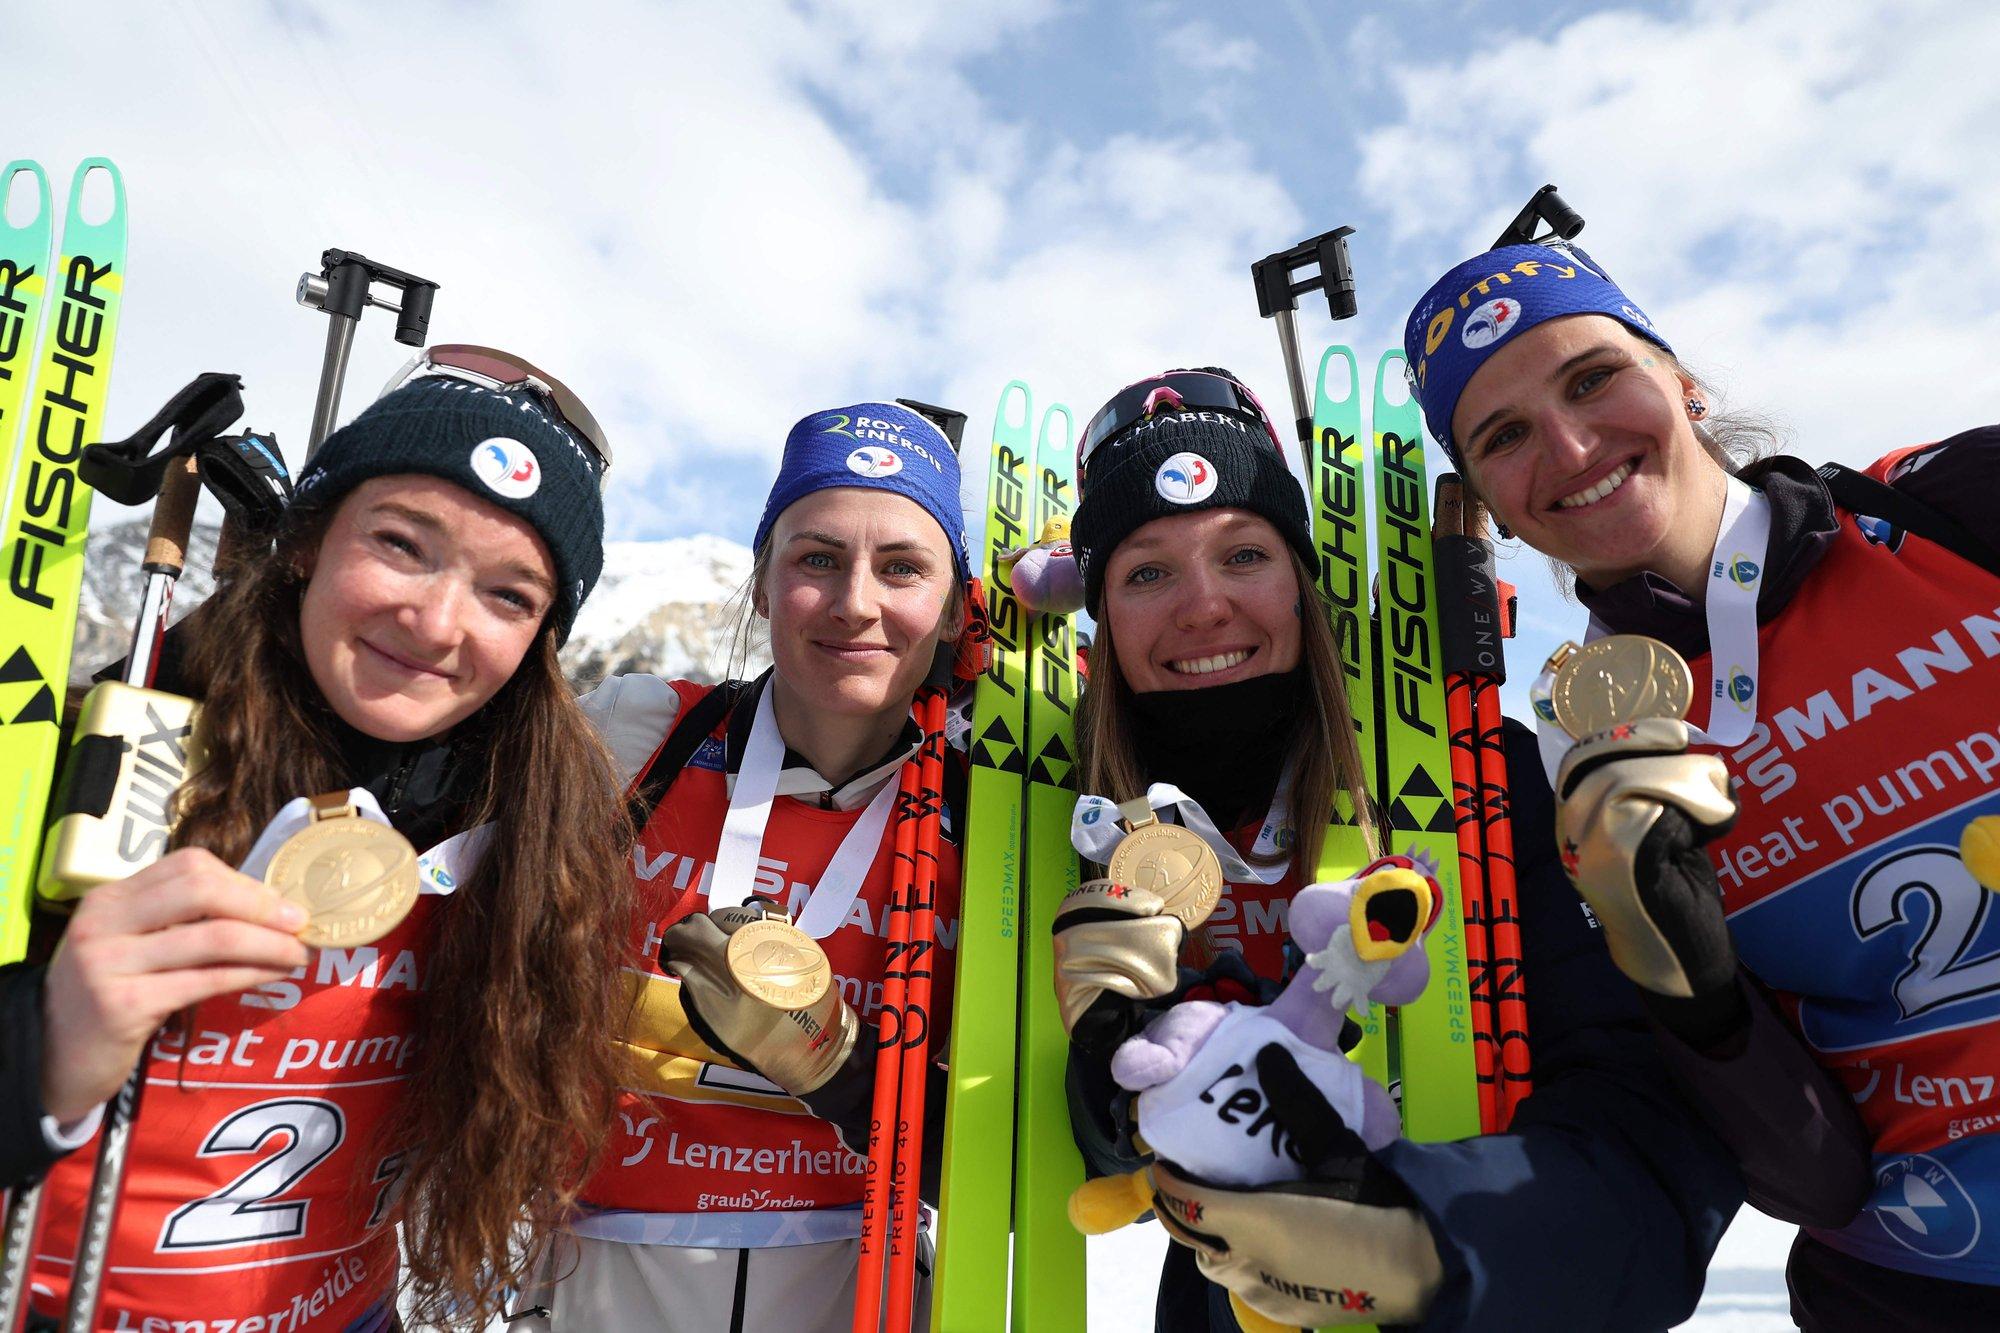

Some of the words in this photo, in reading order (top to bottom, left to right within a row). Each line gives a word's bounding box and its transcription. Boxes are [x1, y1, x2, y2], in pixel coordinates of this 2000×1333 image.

[9, 254, 112, 610] FISCHER
[854, 428, 942, 473] ENERGIE
[856, 416, 907, 433] ROY
[1382, 431, 1436, 738] FISCHER
[1713, 561, 1724, 578] IBU
[1714, 679, 1724, 698] IBU
[1002, 851, 1015, 938] SPEEDMAX
[1849, 843, 2000, 1025] 2
[1444, 933, 1466, 1043] SPEEDMAX
[154, 1096, 347, 1253] 2
[860, 1160, 877, 1255] PREMIO
[870, 1119, 881, 1147] 40
[890, 1161, 907, 1256] PREMIO
[899, 1120, 909, 1148] 40
